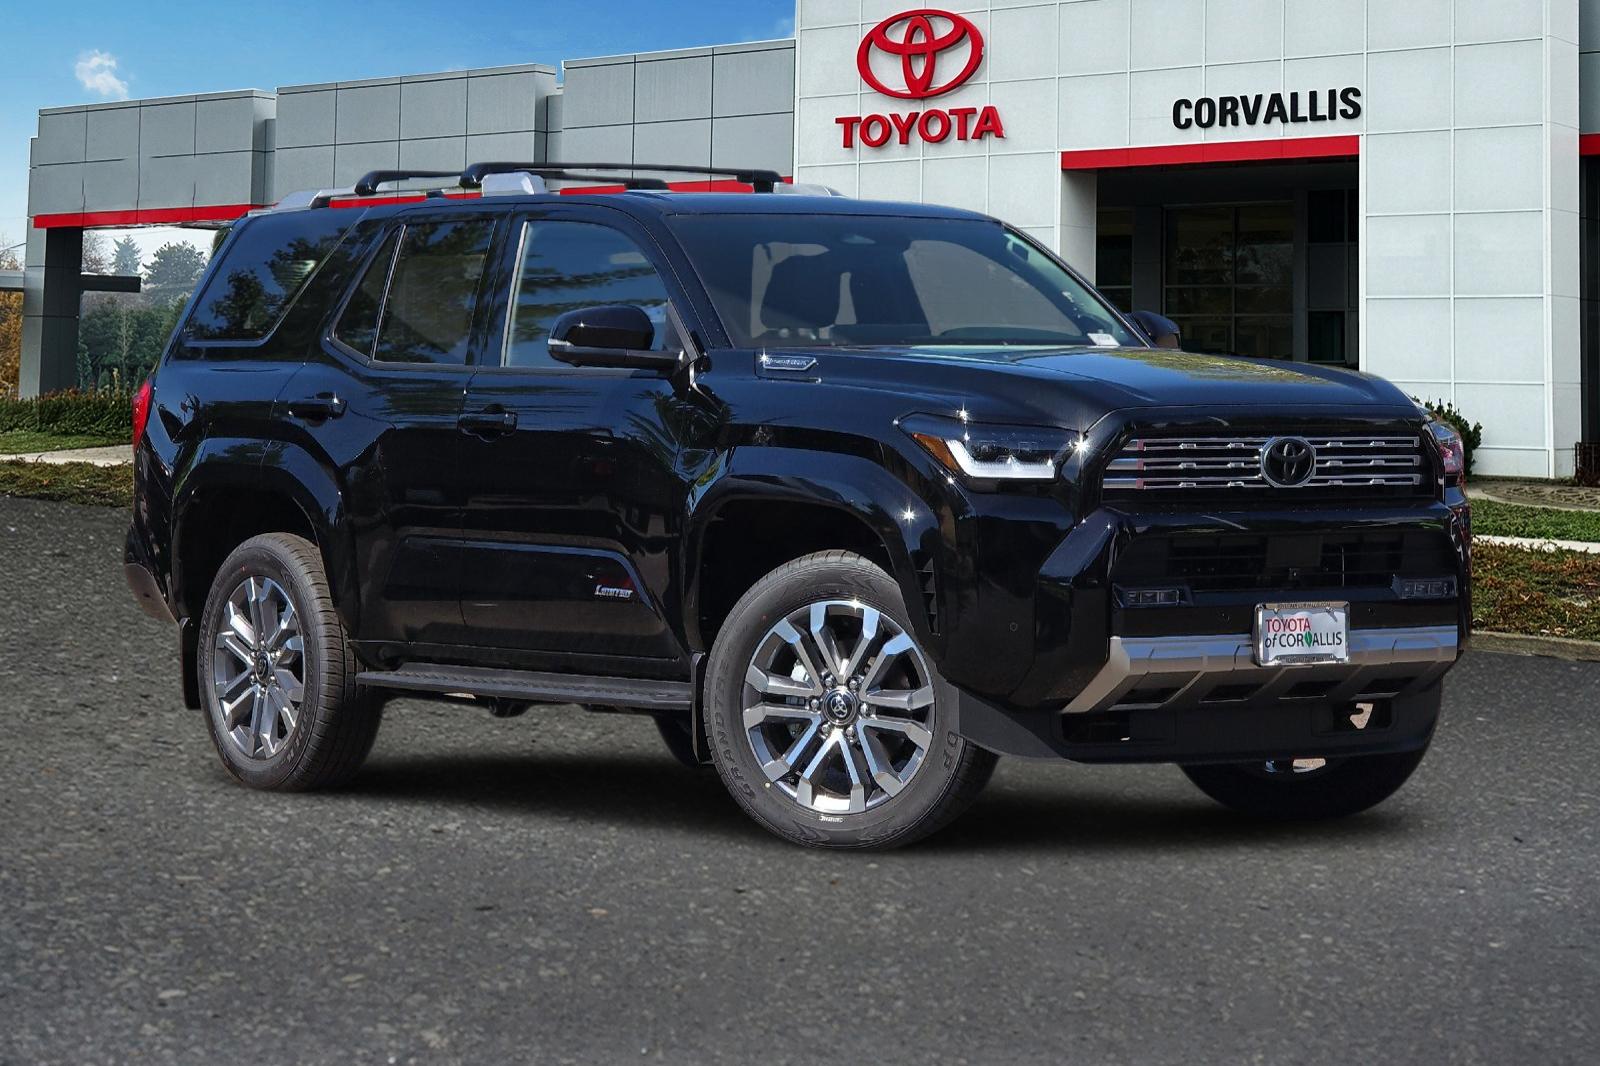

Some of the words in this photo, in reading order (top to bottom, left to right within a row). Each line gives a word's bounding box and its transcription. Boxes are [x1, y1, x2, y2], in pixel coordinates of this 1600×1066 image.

[1172, 86, 1362, 131] CORVALLIS
[835, 105, 1006, 150] TOYOTA
[1265, 617, 1312, 633] TOYOTA
[1264, 633, 1278, 649] of
